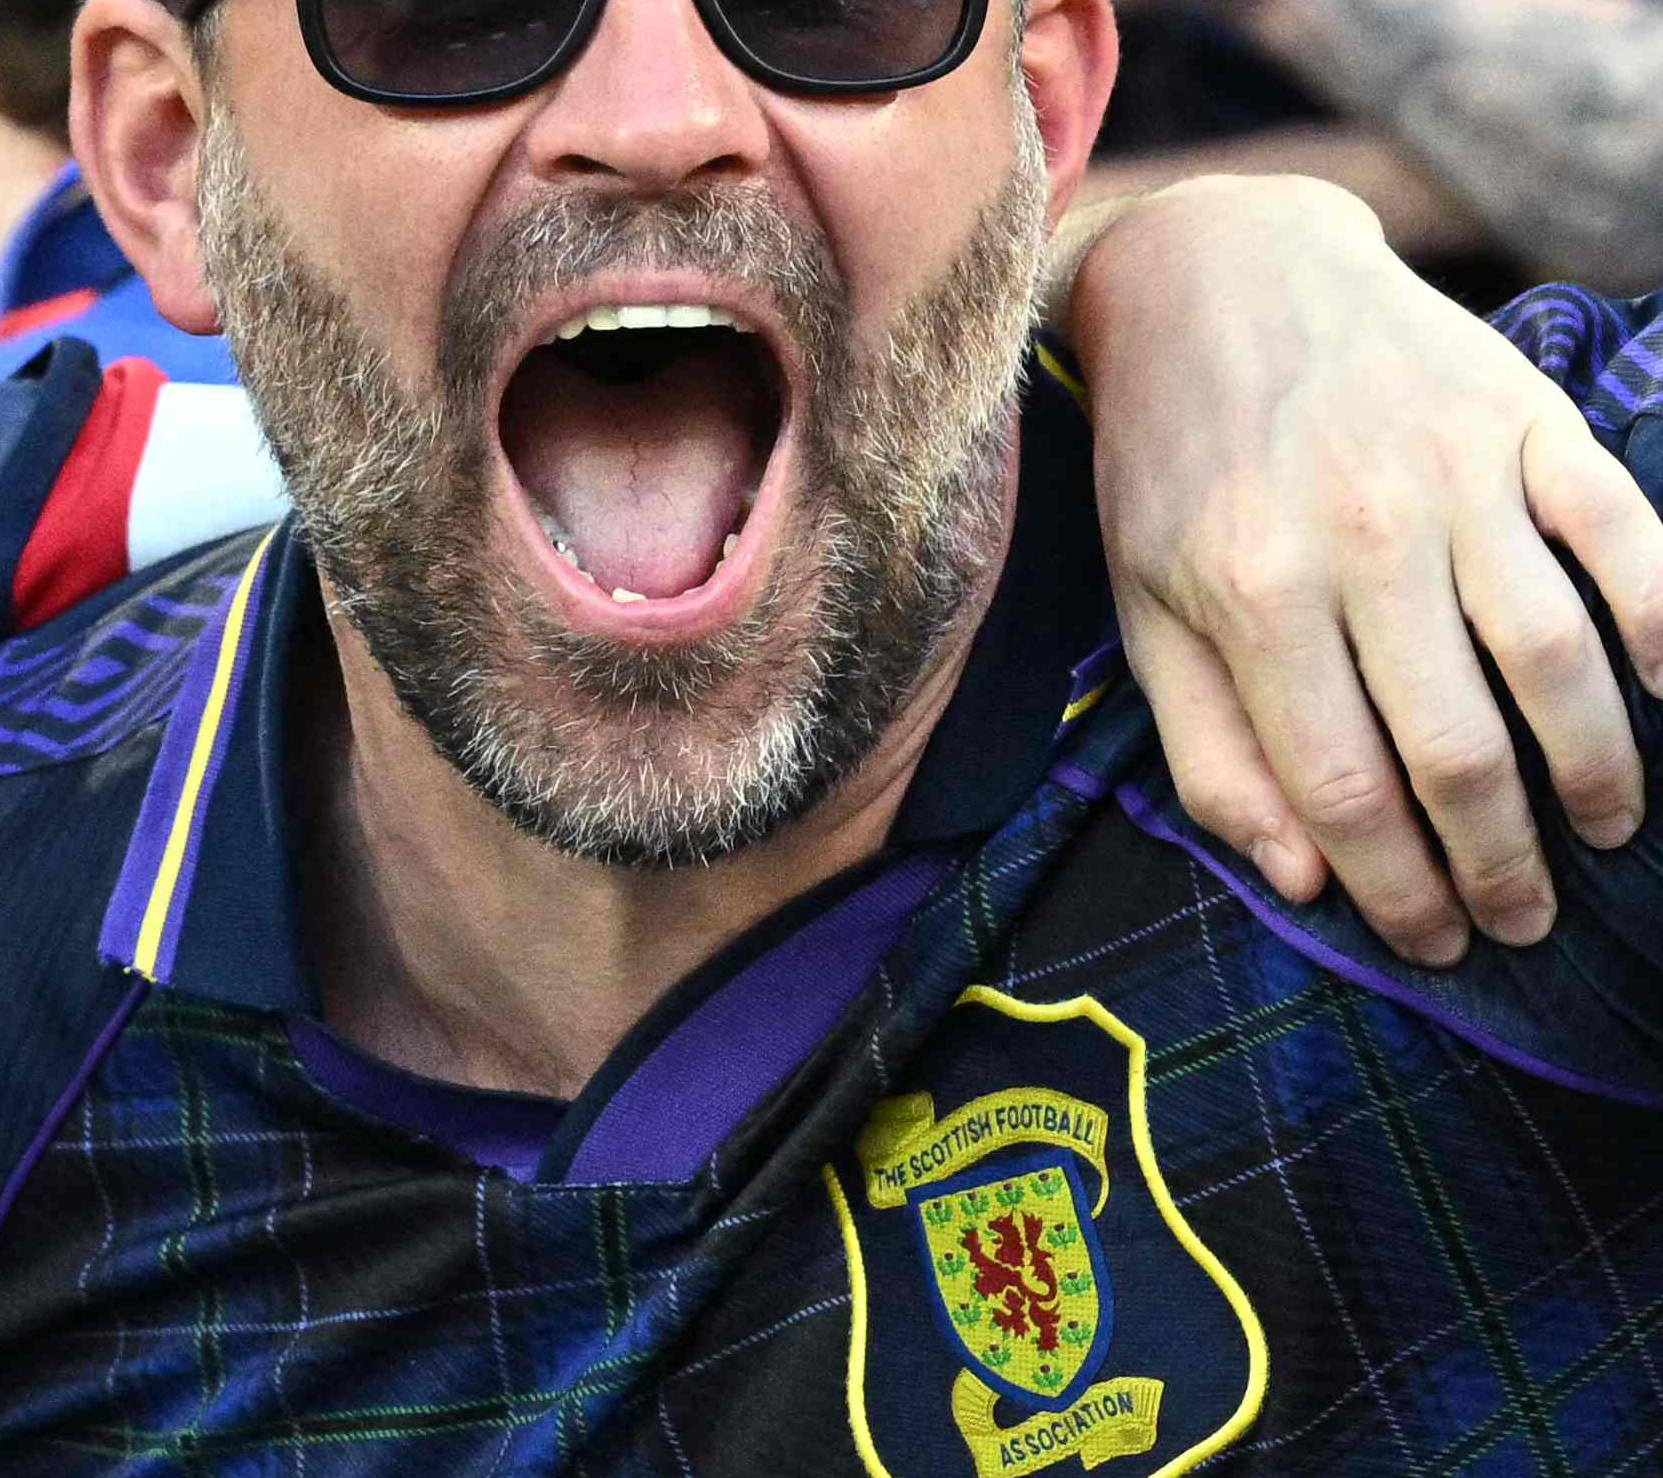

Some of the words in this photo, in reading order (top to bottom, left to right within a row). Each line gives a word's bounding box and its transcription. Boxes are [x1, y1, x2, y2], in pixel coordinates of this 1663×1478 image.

[876, 1163, 907, 1189] THE
[909, 1112, 992, 1180] SCOTTISH
[994, 1104, 1096, 1146] FOOTBALL
[999, 1390, 1135, 1469] ASSOCIATION
